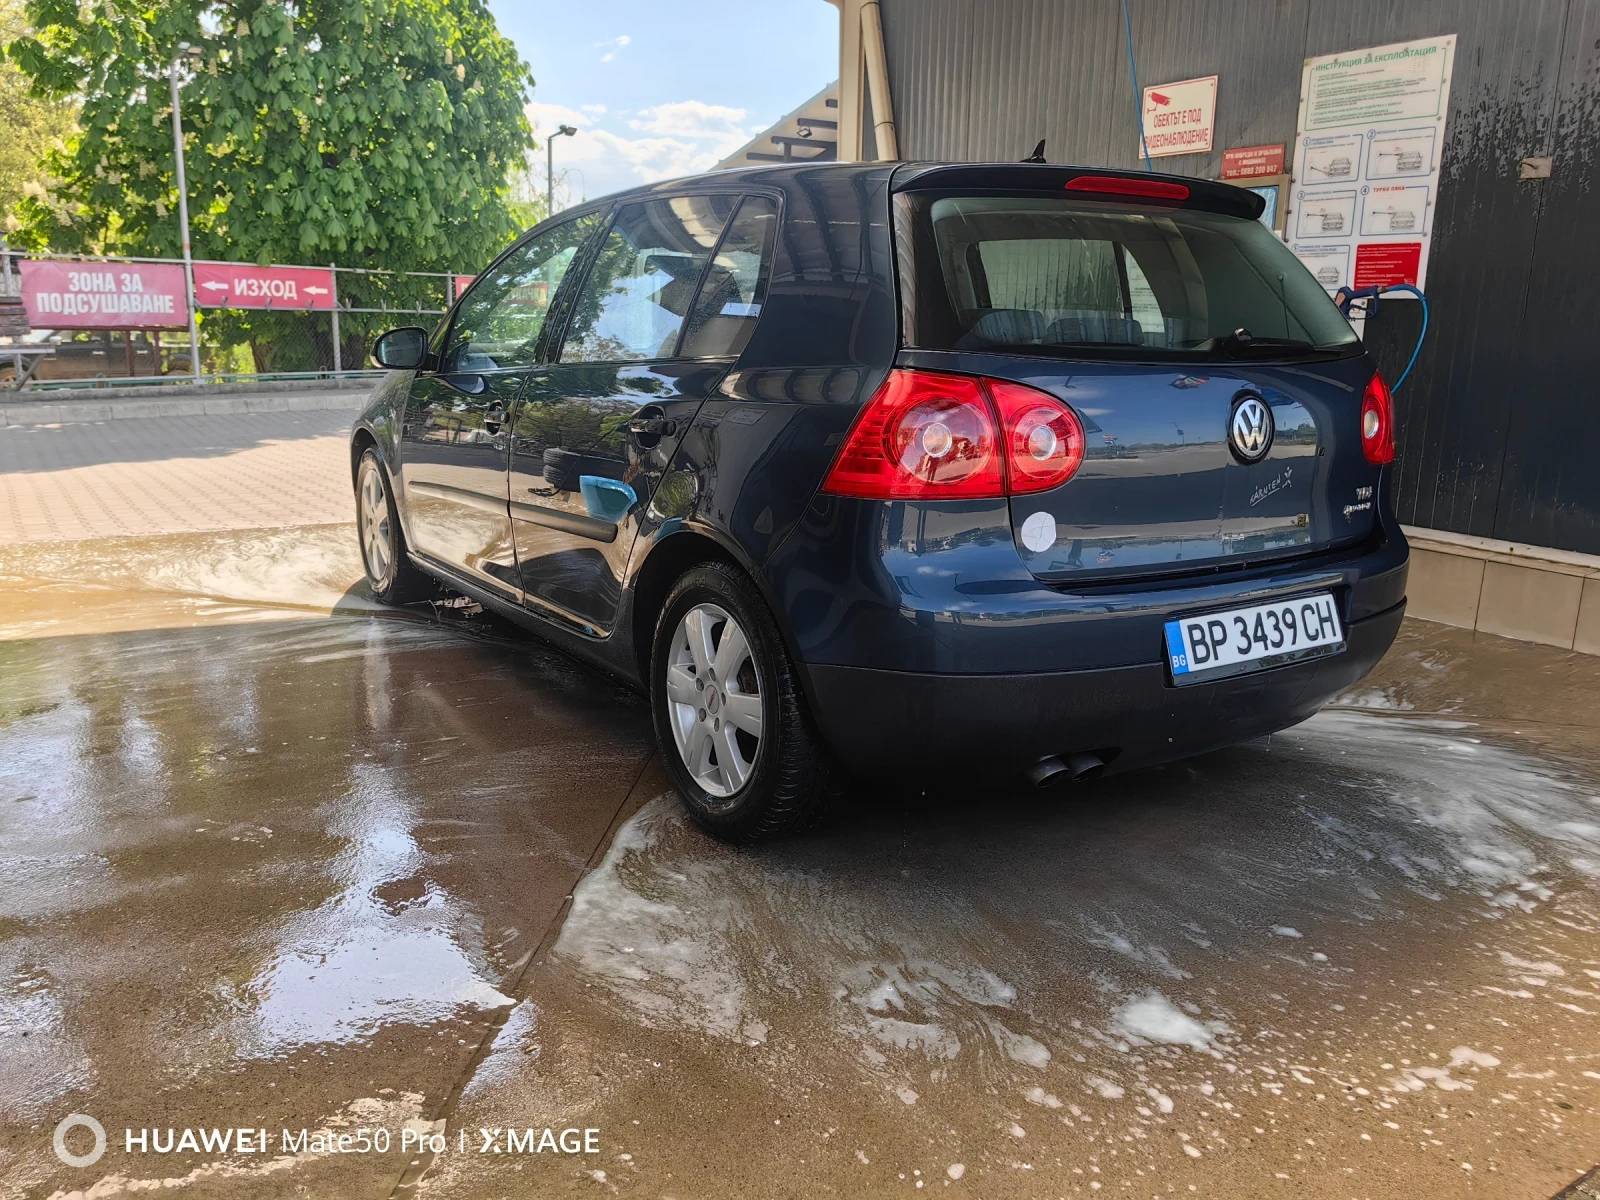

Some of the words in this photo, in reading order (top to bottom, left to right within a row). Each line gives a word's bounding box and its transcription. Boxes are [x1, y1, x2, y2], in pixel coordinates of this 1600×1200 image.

[1315, 58, 1362, 72] ИНСТРУКЦИЯ
[1374, 46, 1437, 63] ЕКСПЛОАТАЦИЯ
[1153, 111, 1181, 128] ОБЕКТЪТ
[1182, 110, 1187, 124] Е
[1188, 108, 1202, 125] ПОД
[68, 272, 117, 293] ЗОНА
[120, 273, 144, 293] ЗА
[234, 278, 298, 300] ИЗХОД
[36, 293, 175, 315] ПОДСУШАВАНЕ
[1233, 607, 1298, 655] 3439
[1172, 654, 1186, 668] BG
